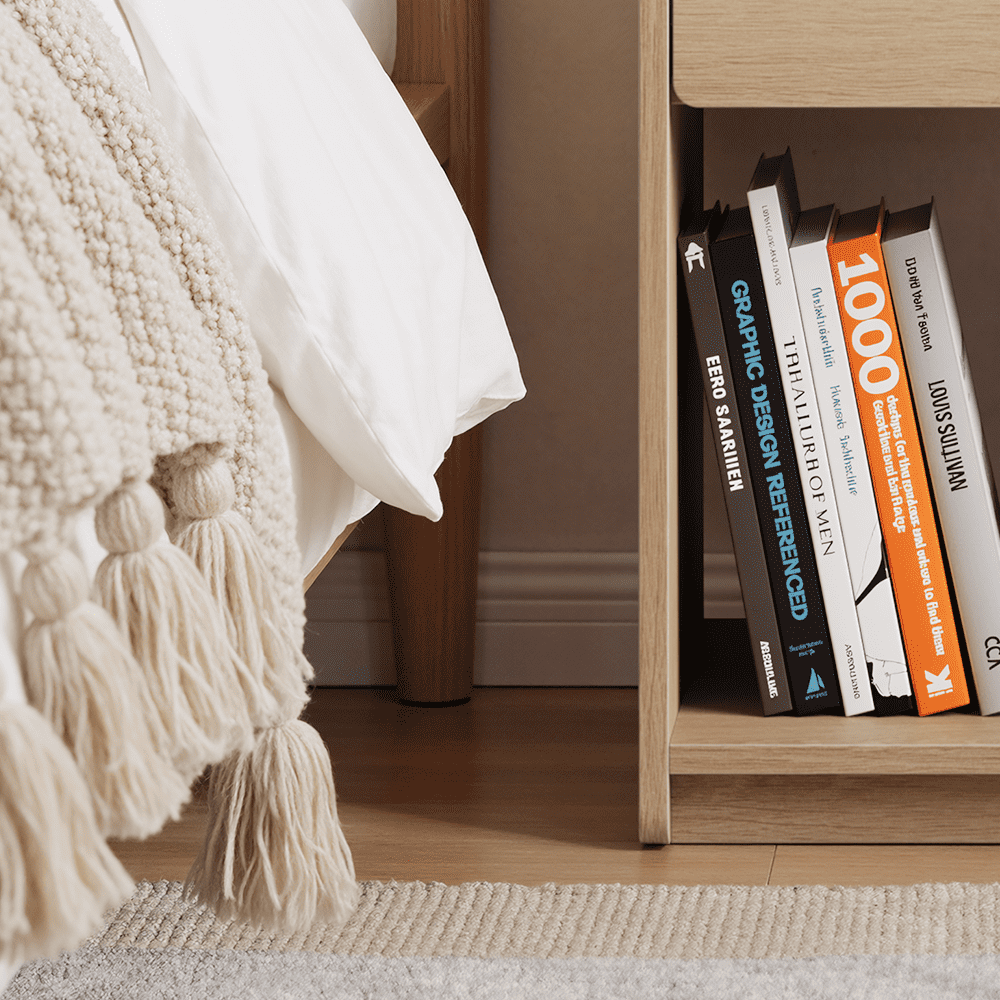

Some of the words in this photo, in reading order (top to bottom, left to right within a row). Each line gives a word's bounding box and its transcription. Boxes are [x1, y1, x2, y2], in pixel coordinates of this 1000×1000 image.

[730, 279, 764, 380] GRAPHIC
[837, 252, 900, 394] 1000
[705, 355, 726, 399] EERO
[927, 378, 952, 422] LOUIS
[750, 383, 781, 469] DESIGN
[765, 471, 808, 620] REFERENCED
[816, 508, 835, 556] MEN
